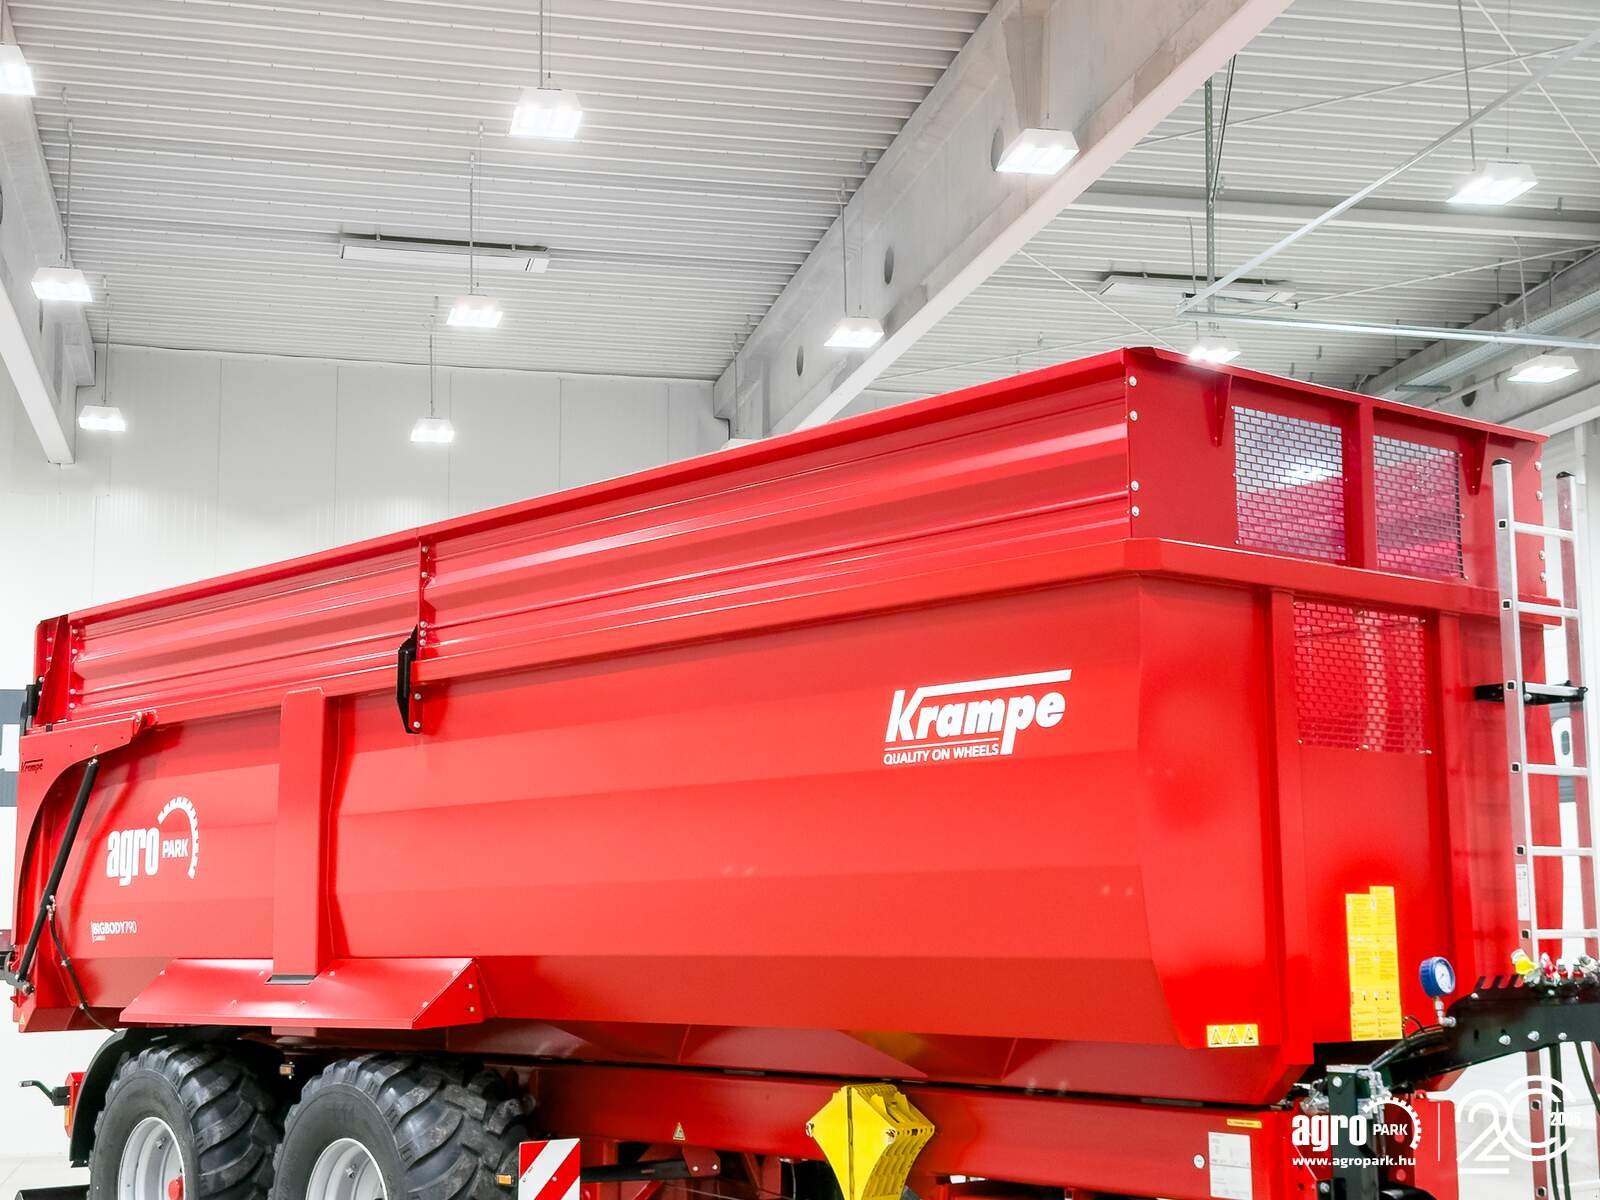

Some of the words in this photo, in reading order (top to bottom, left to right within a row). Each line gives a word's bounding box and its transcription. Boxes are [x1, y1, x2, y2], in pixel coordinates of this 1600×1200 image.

[885, 669, 1072, 755] Krampe
[883, 749, 930, 765] QUALITY
[932, 747, 951, 761] ON
[953, 743, 1000, 759] WHEELS
[106, 827, 160, 887] agro
[162, 839, 189, 858] PARK
